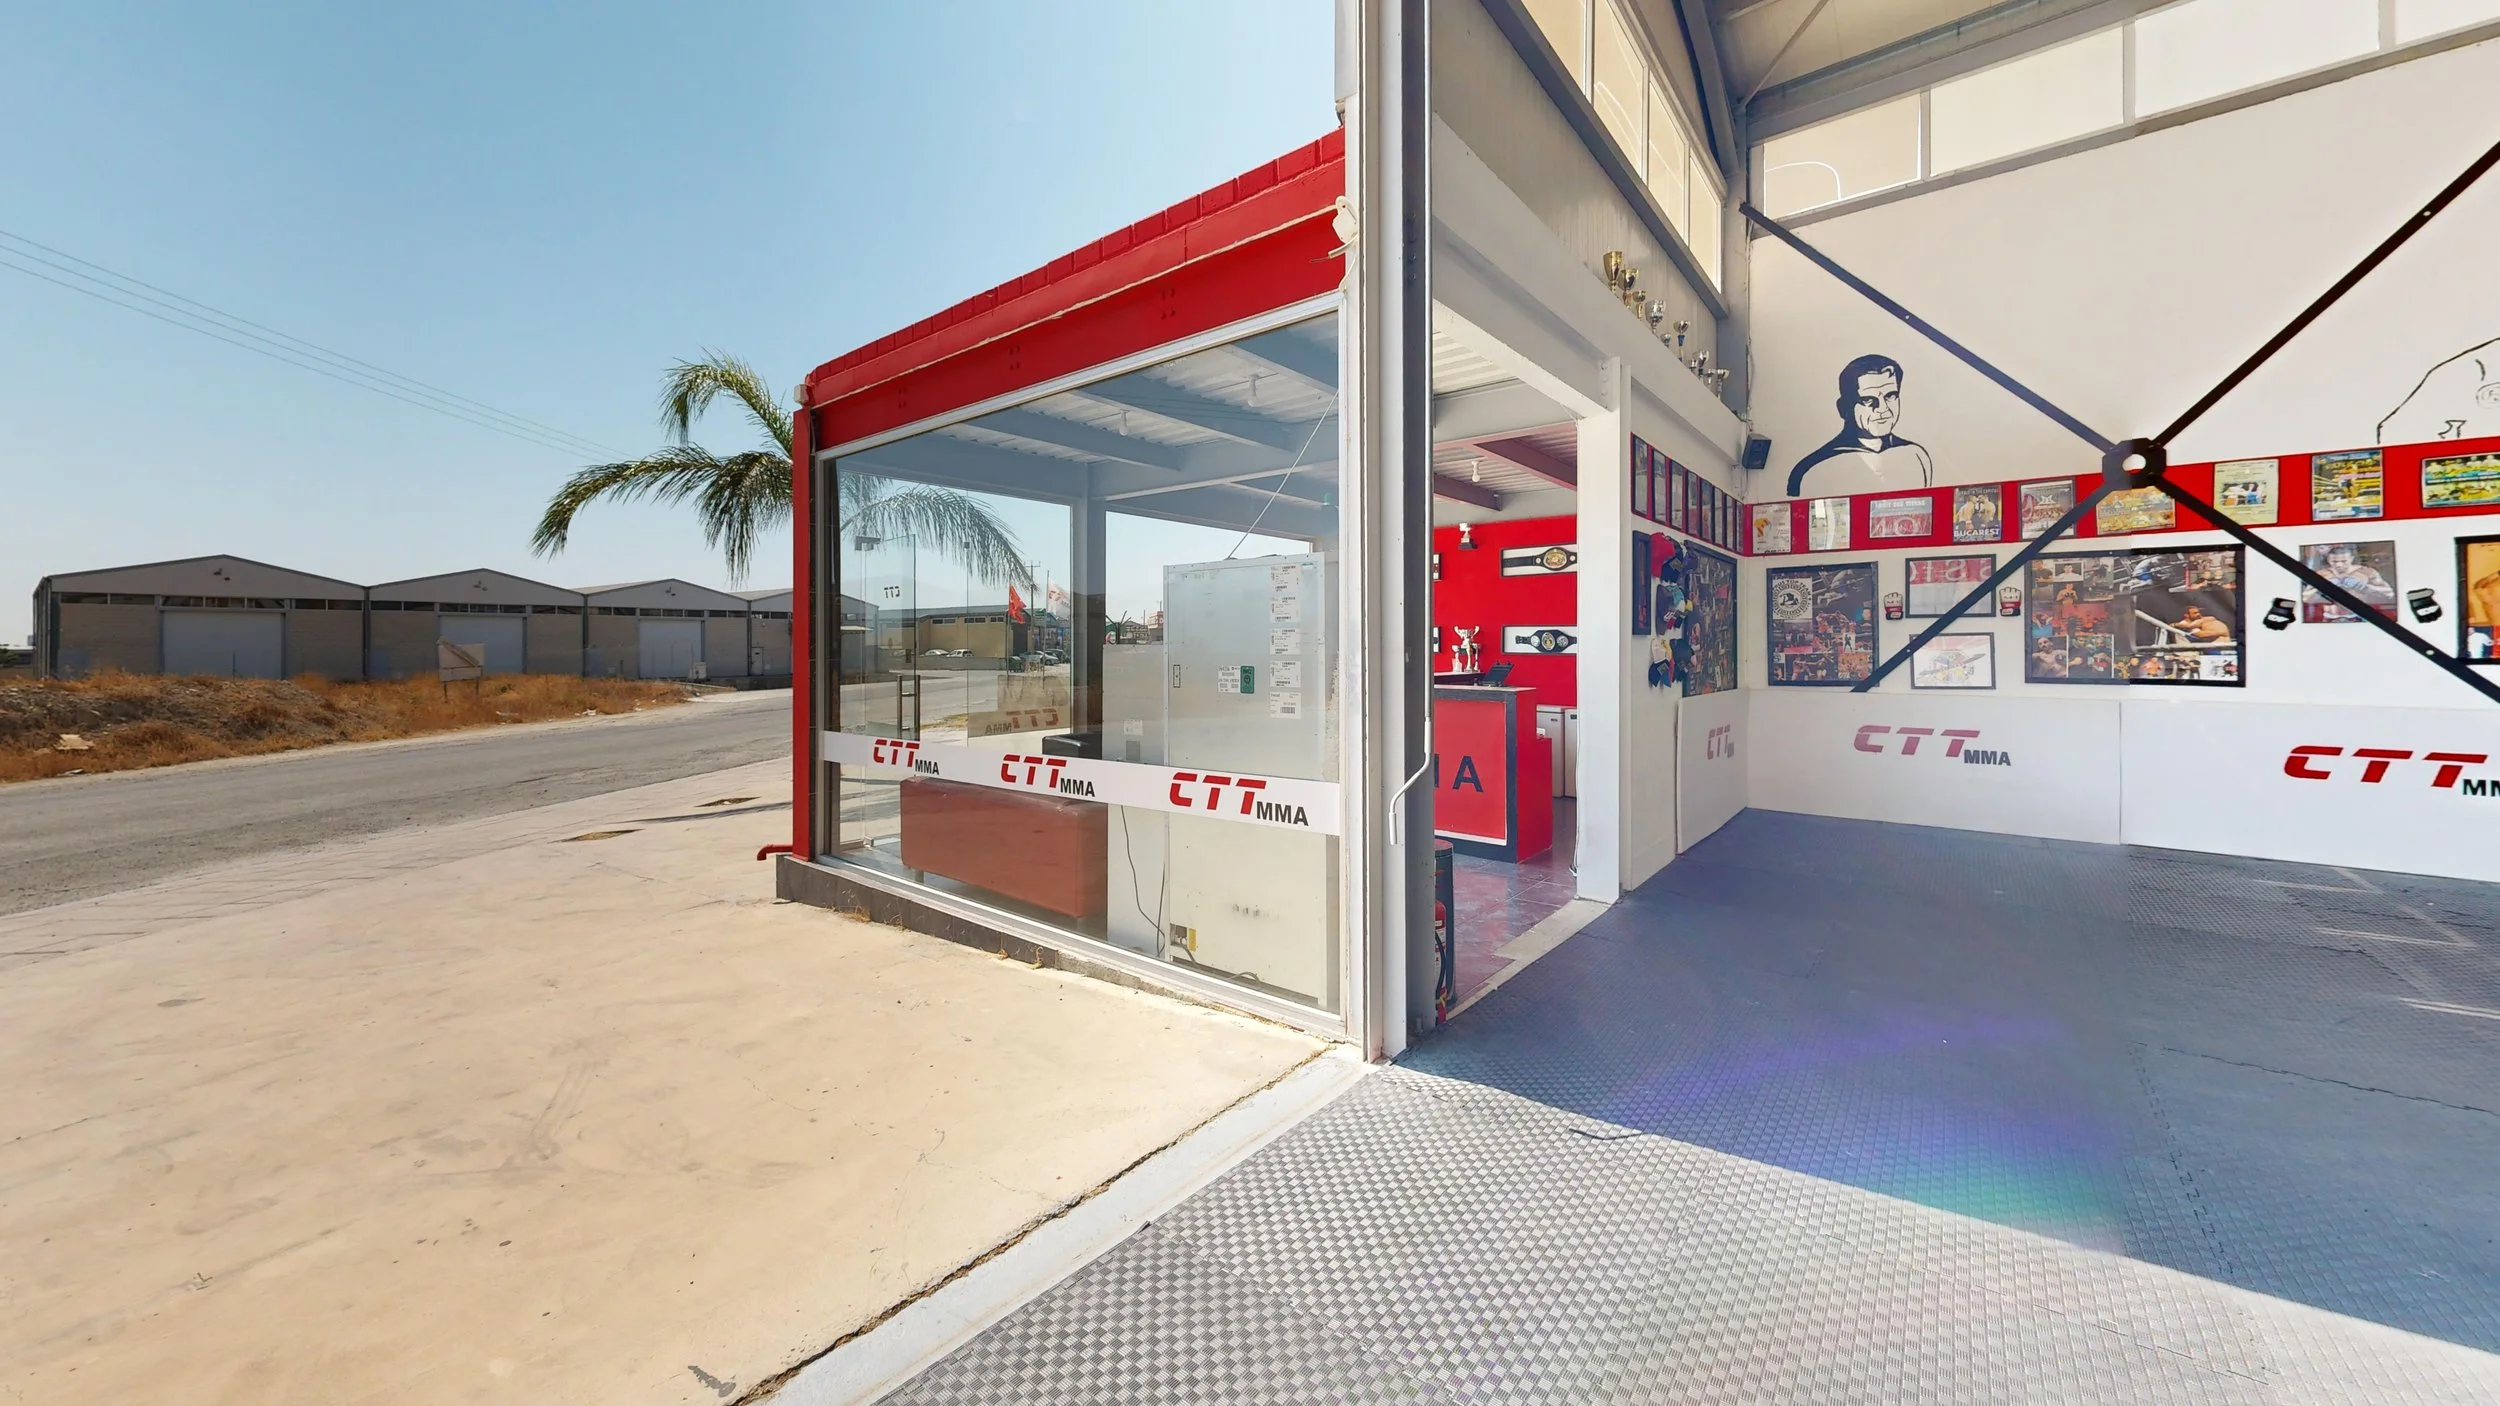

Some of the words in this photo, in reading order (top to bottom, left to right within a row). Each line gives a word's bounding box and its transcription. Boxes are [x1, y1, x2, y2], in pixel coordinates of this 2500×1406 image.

[1954, 528, 2000, 537] BUCAREST
[874, 739, 920, 768] CTT
[914, 760, 940, 776] MMA
[1854, 725, 1981, 758] CTT
[1963, 750, 2012, 767] MMA
[2284, 745, 2489, 788] CTT
[1000, 754, 1066, 789] CTT
[1060, 777, 1095, 798] MMA
[1434, 753, 1484, 793] A
[1169, 772, 1267, 815] CTT
[1256, 800, 1309, 827] MMA
